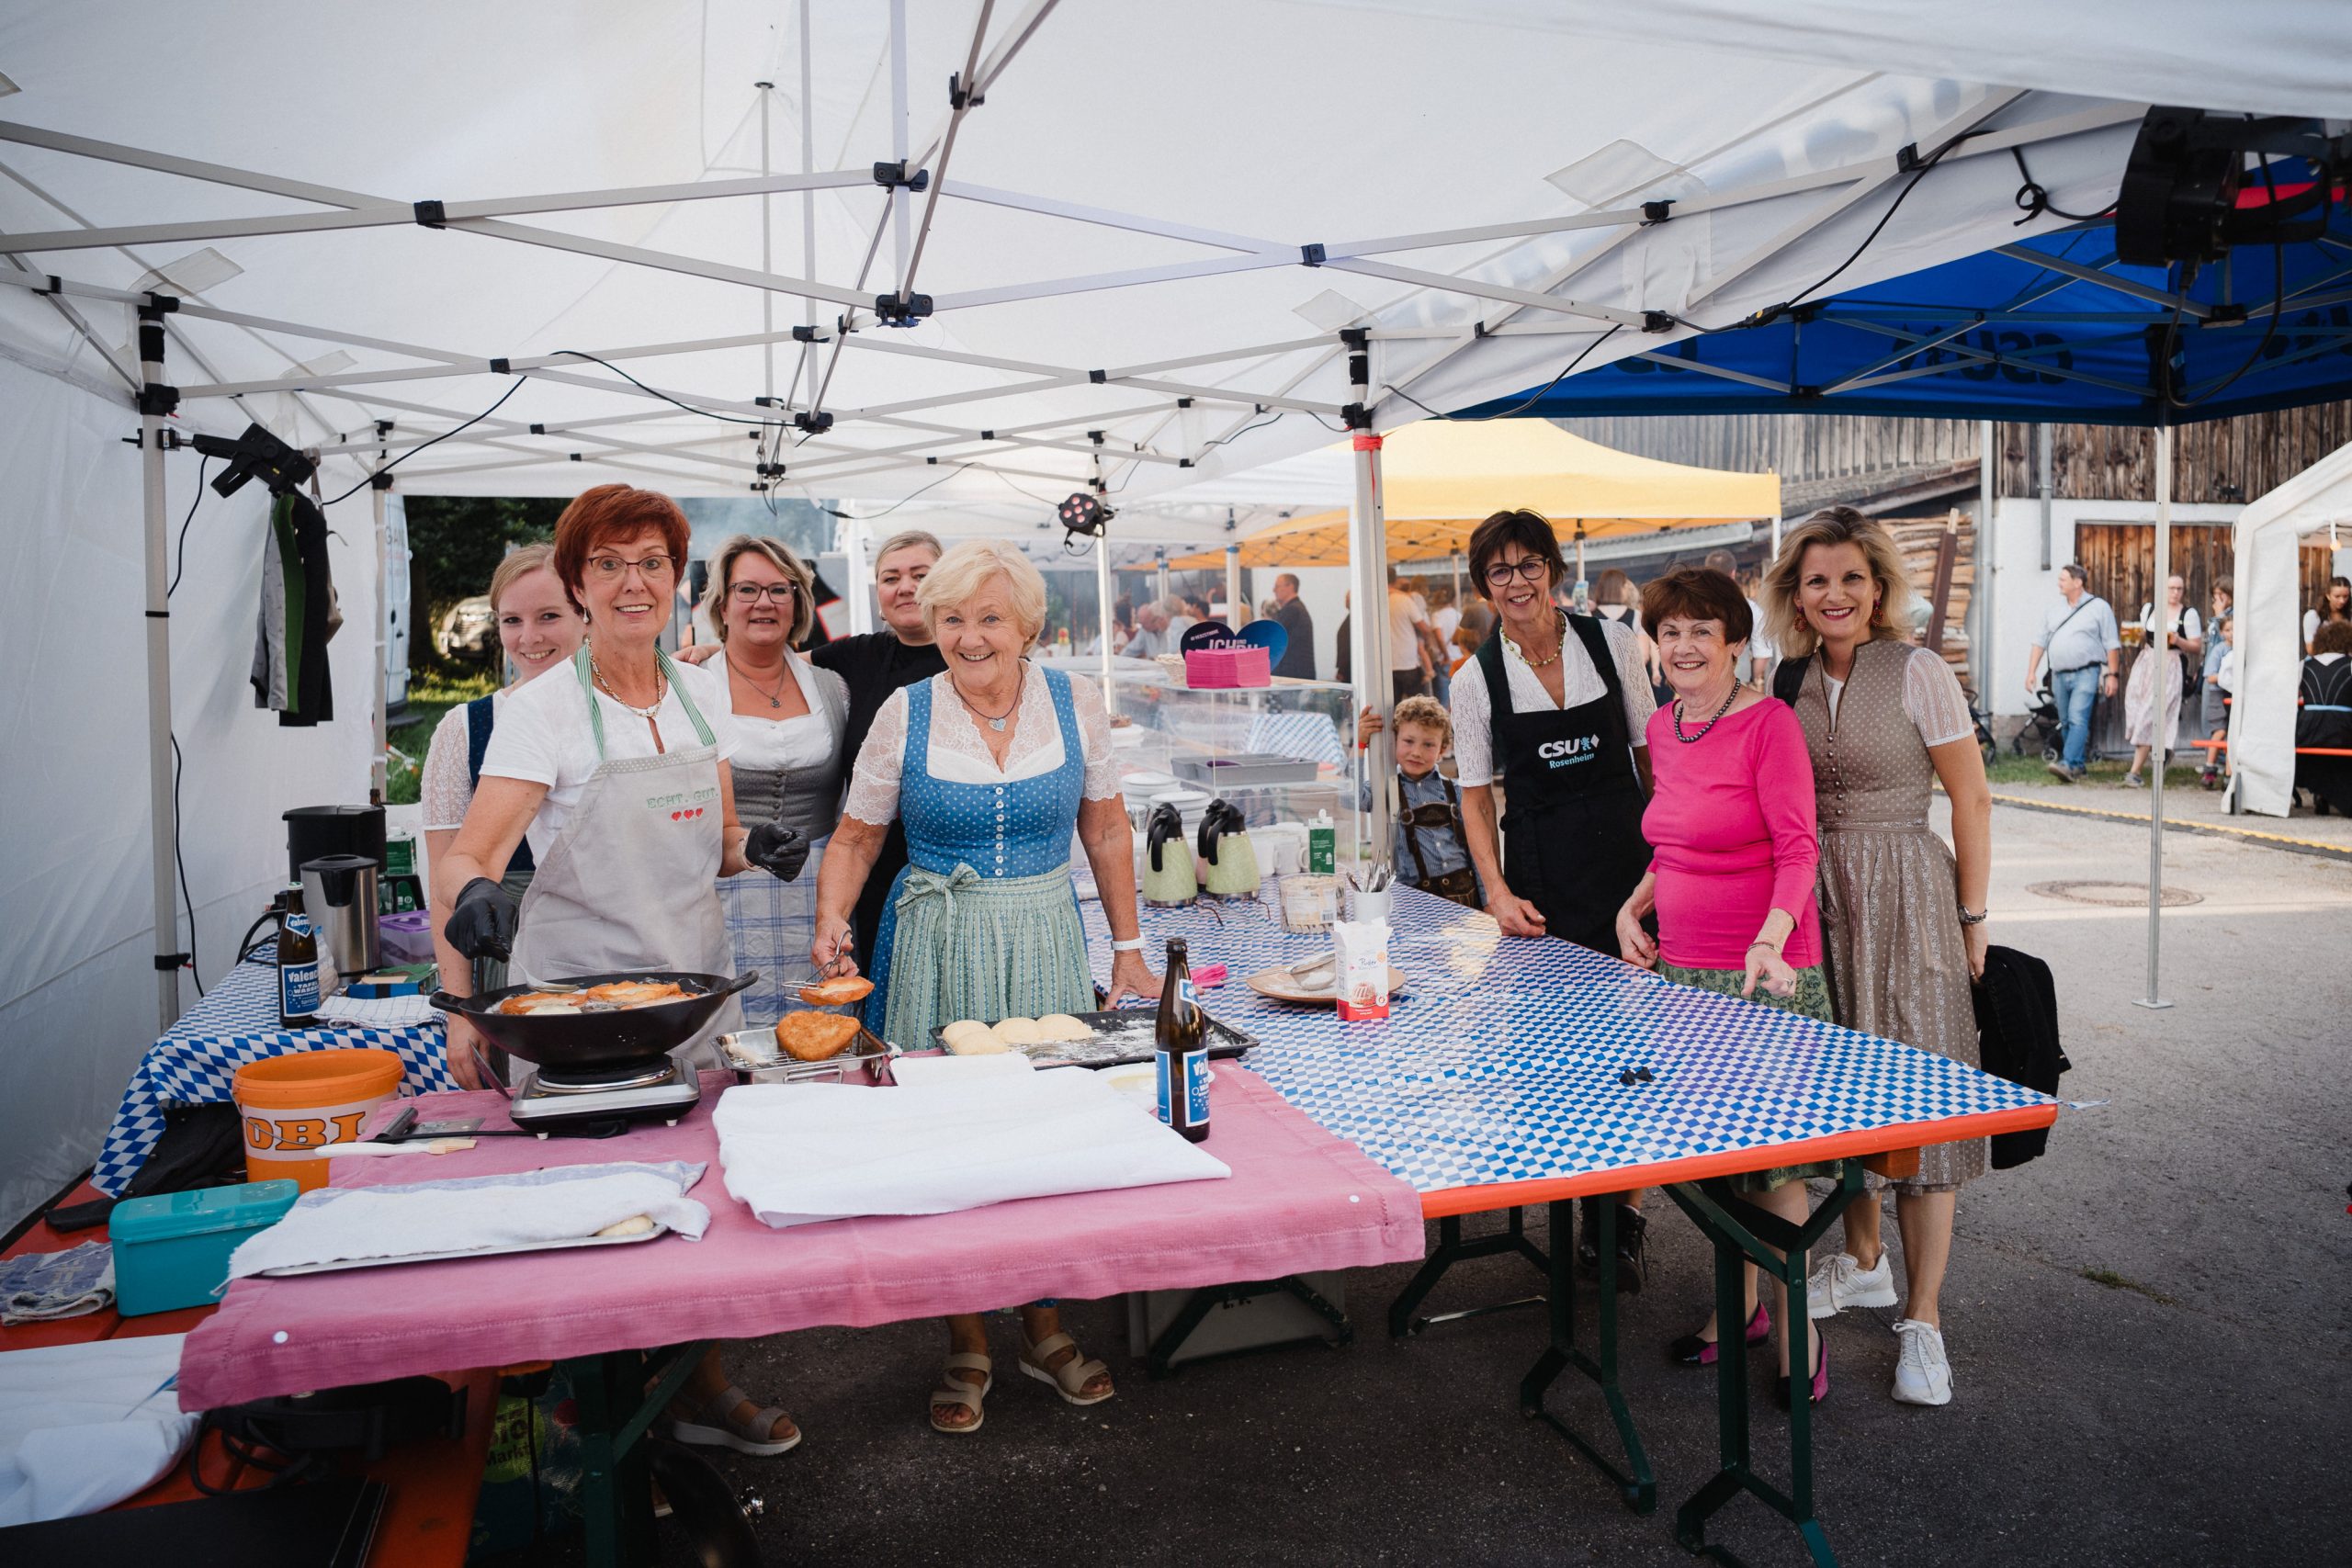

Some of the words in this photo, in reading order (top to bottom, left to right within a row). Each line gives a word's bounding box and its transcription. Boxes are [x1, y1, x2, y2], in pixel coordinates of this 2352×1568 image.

[1538, 738, 1580, 759] CSU
[1549, 752, 1595, 769] Rosenheim
[246, 1111, 366, 1150] OBI
